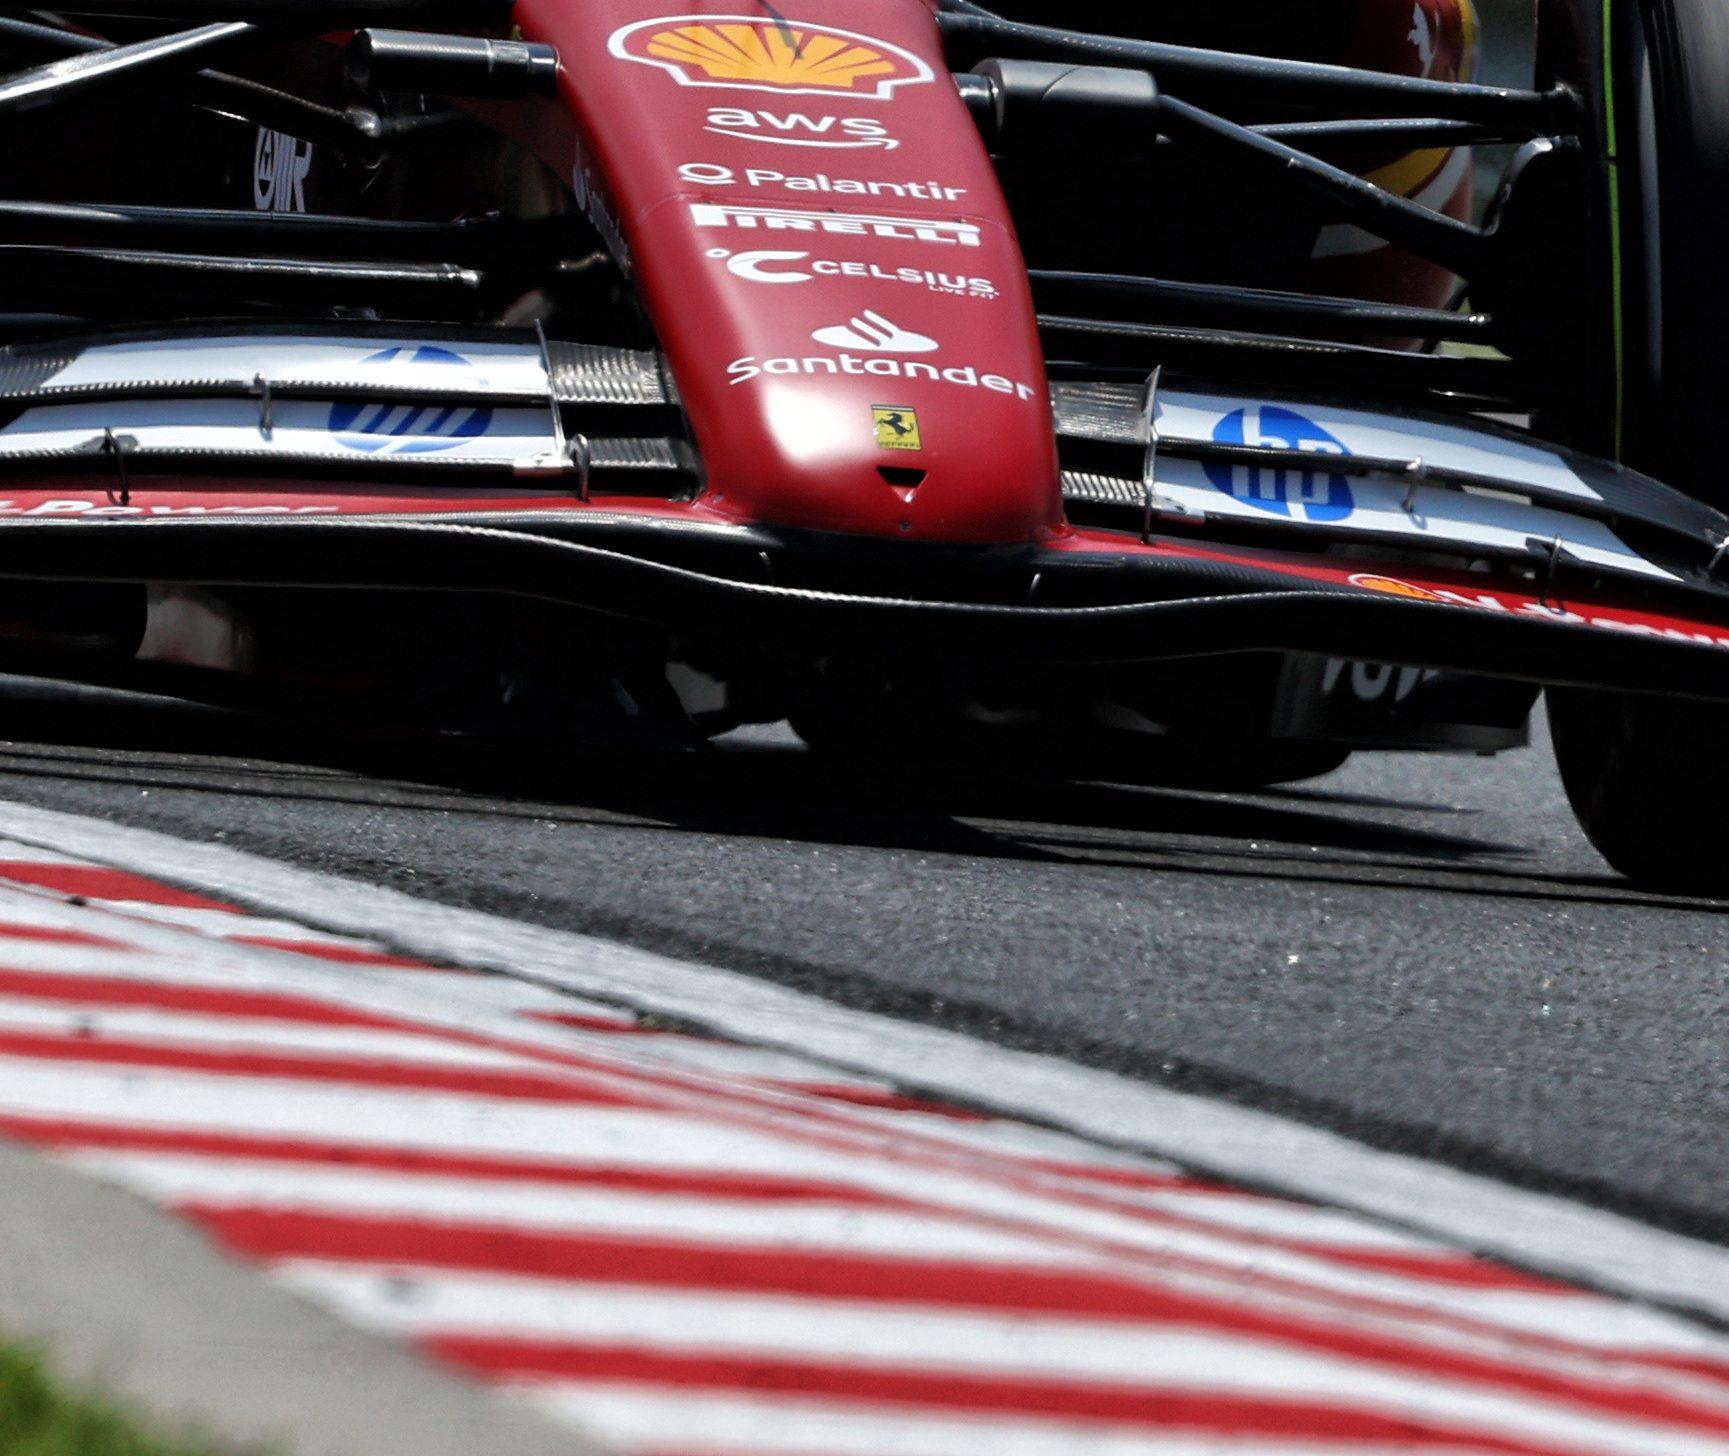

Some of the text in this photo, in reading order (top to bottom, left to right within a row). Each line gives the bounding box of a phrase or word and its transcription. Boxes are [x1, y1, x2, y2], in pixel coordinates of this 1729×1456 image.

[705, 106, 888, 137] aws
[745, 169, 968, 202] Palantir
[689, 203, 982, 247] PIRELLI
[811, 259, 995, 293] CELSIUS
[726, 354, 1036, 402] Santander
[1227, 405, 1343, 522] hp
